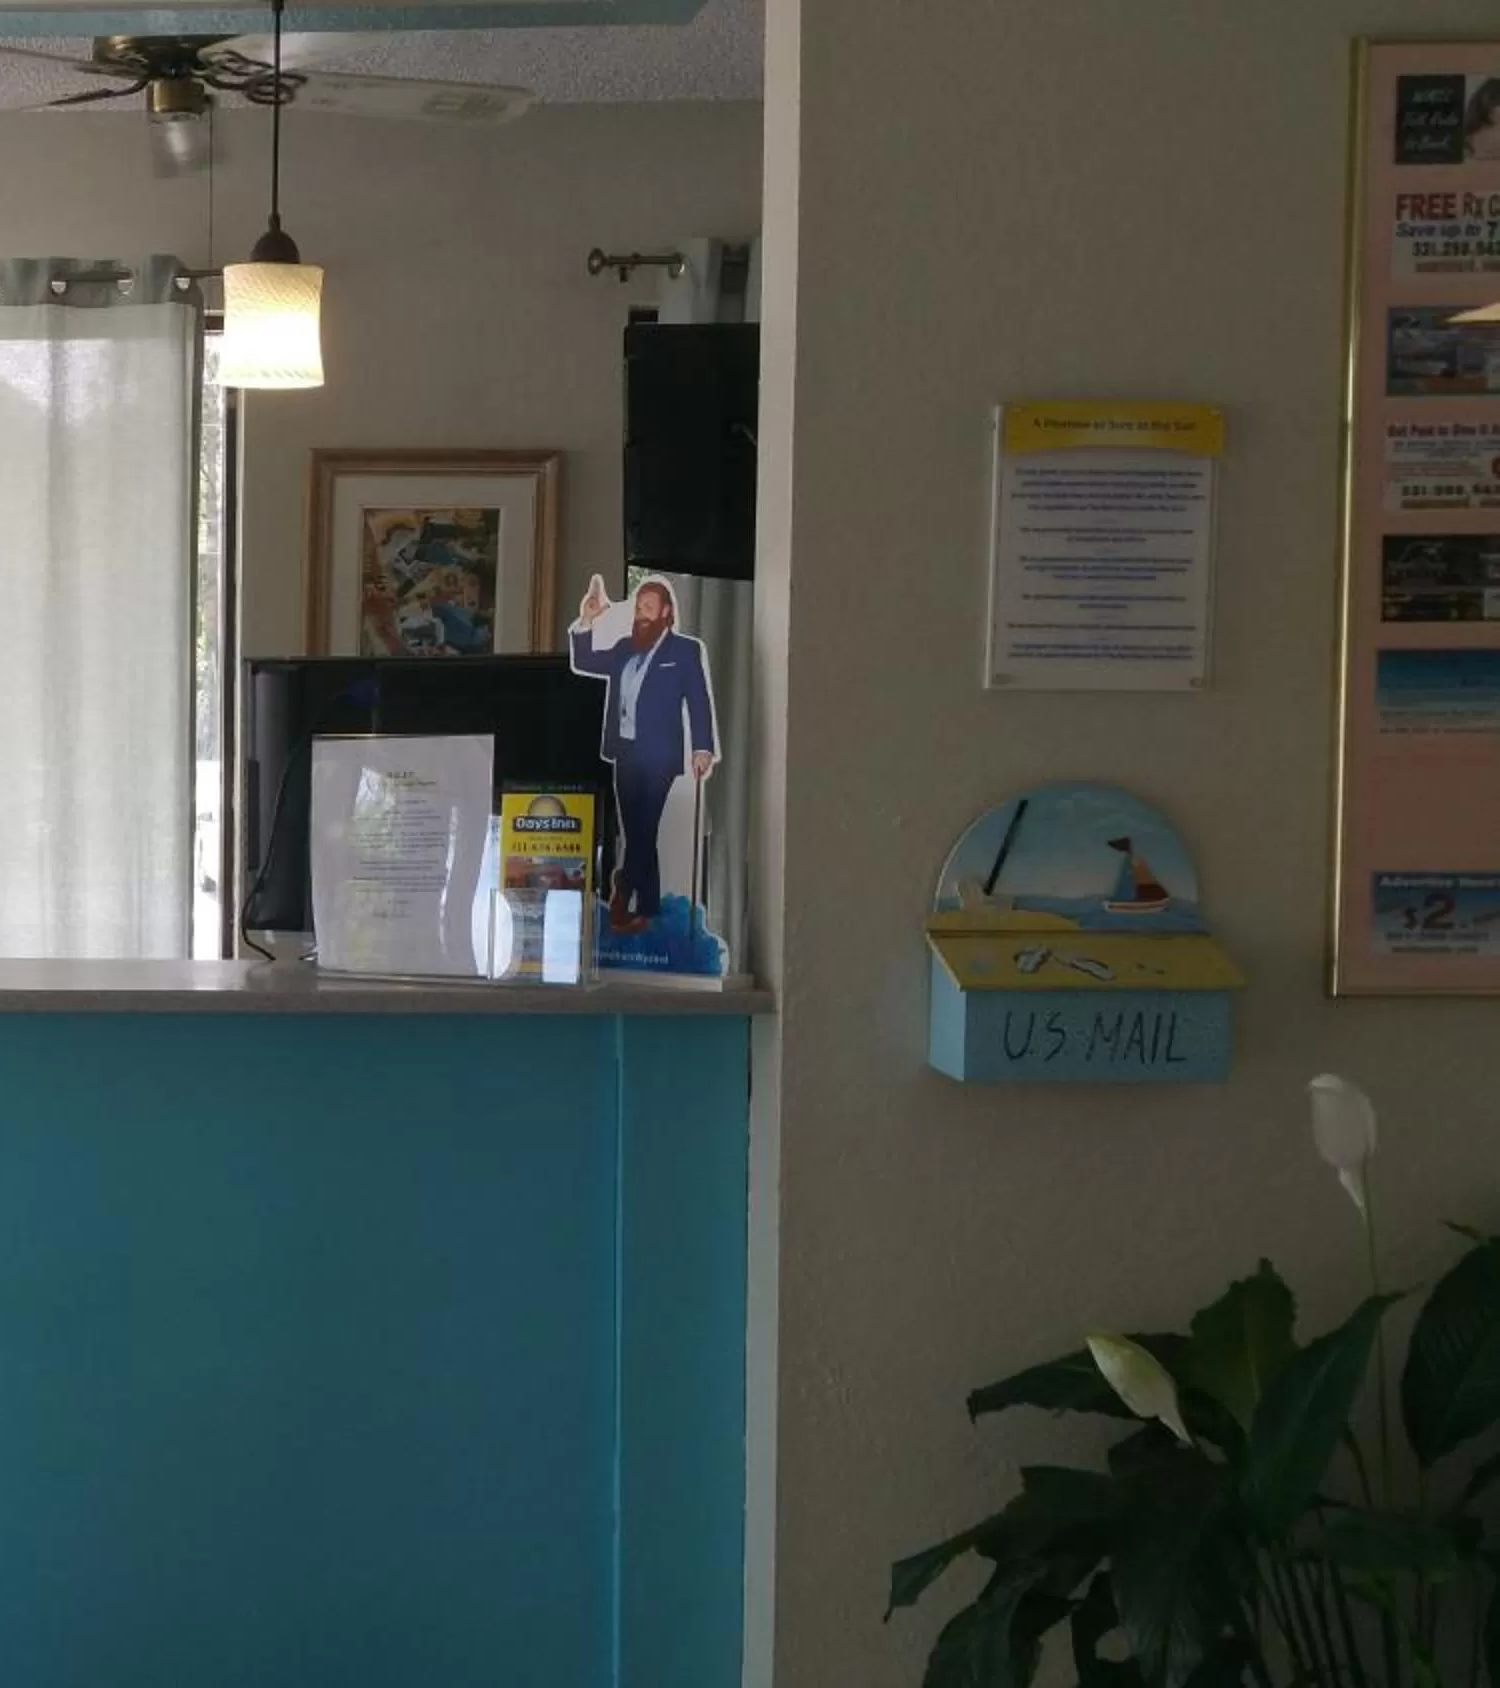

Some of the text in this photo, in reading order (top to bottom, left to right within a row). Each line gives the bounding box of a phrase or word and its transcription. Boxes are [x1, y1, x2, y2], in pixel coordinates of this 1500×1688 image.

[1396, 193, 1457, 220] FREE
[1396, 222, 1435, 238] Save
[516, 817, 576, 831] Days Inn
[1085, 1010, 1188, 1065] MAIL
